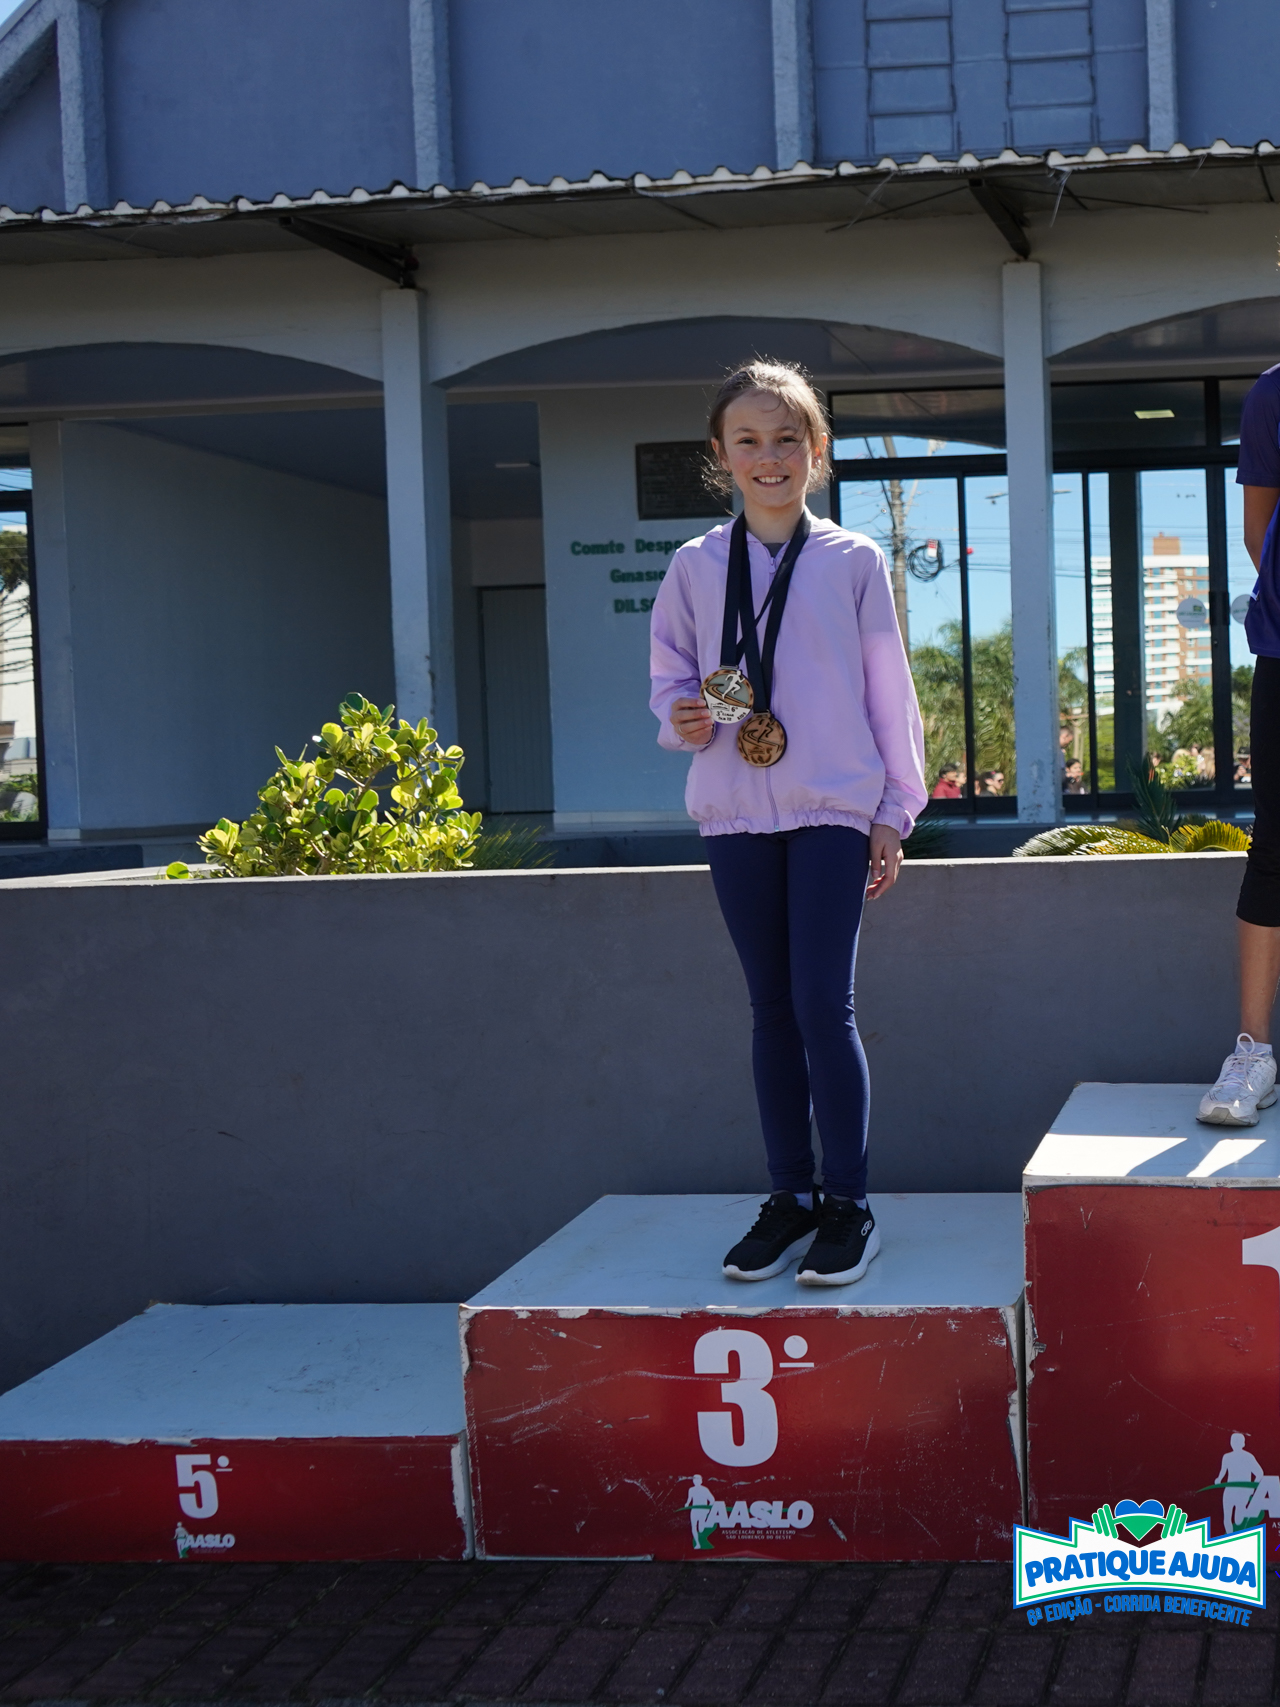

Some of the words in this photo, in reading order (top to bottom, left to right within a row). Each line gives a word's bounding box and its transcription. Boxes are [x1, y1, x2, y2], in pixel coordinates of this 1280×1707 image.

[635, 538, 686, 555] Despo
[704, 1500, 815, 1529] AASLO
[184, 1533, 236, 1548] AASLO
